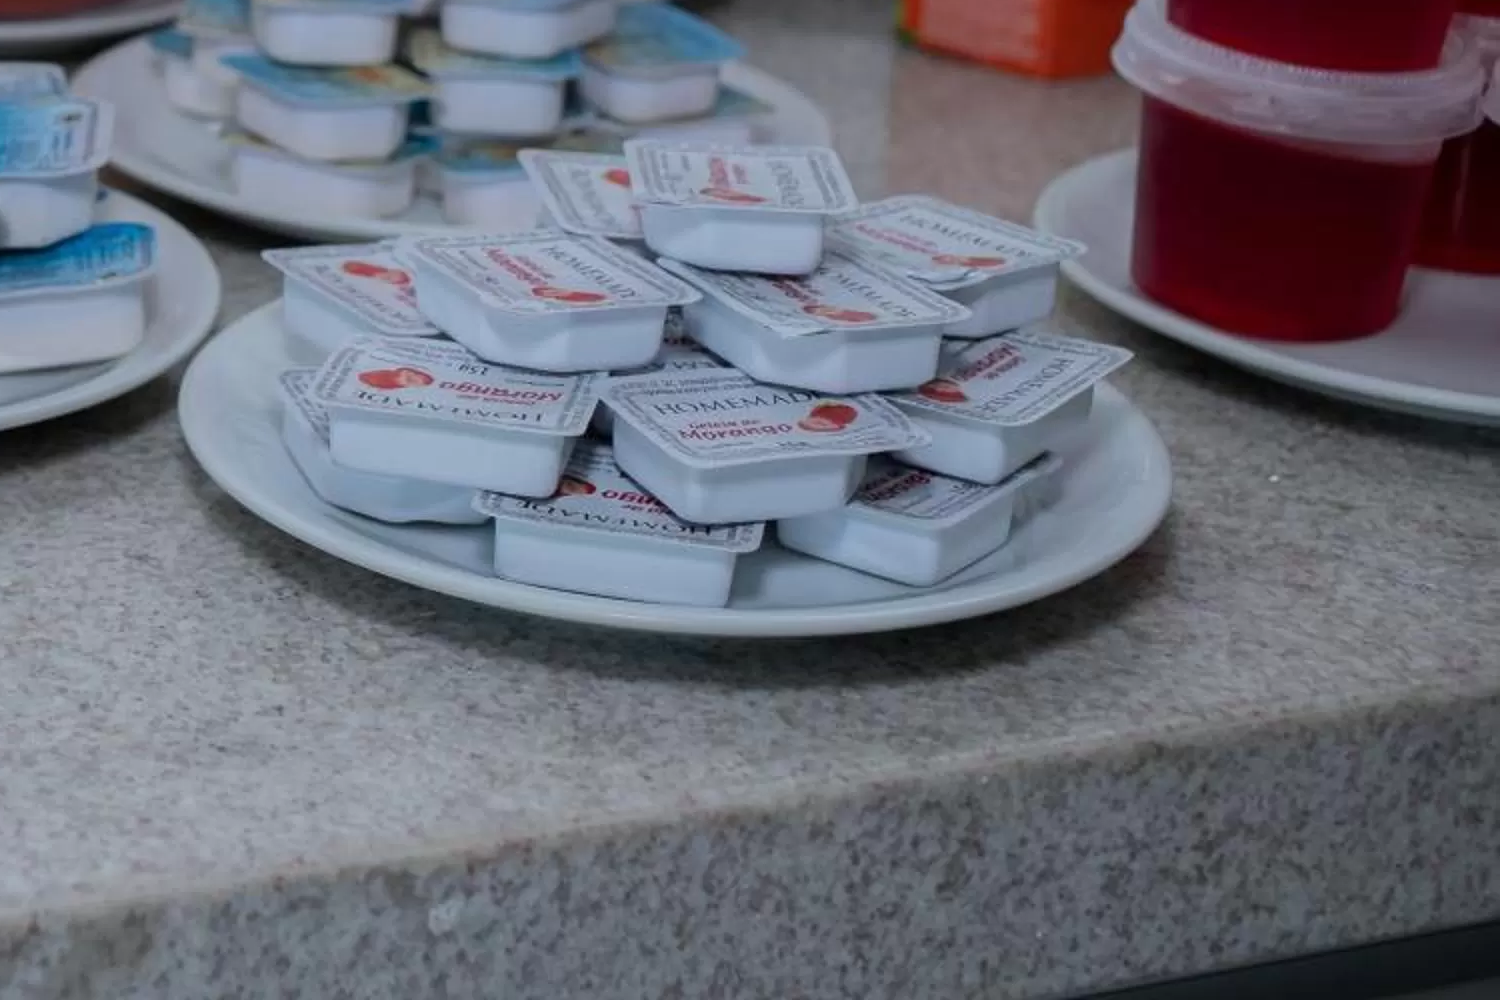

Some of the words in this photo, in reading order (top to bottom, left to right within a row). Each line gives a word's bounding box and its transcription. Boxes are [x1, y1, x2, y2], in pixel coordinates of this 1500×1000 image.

[437, 380, 564, 401] Morango
[653, 390, 821, 416] HOMEMAD
[679, 422, 793, 441] Morango
